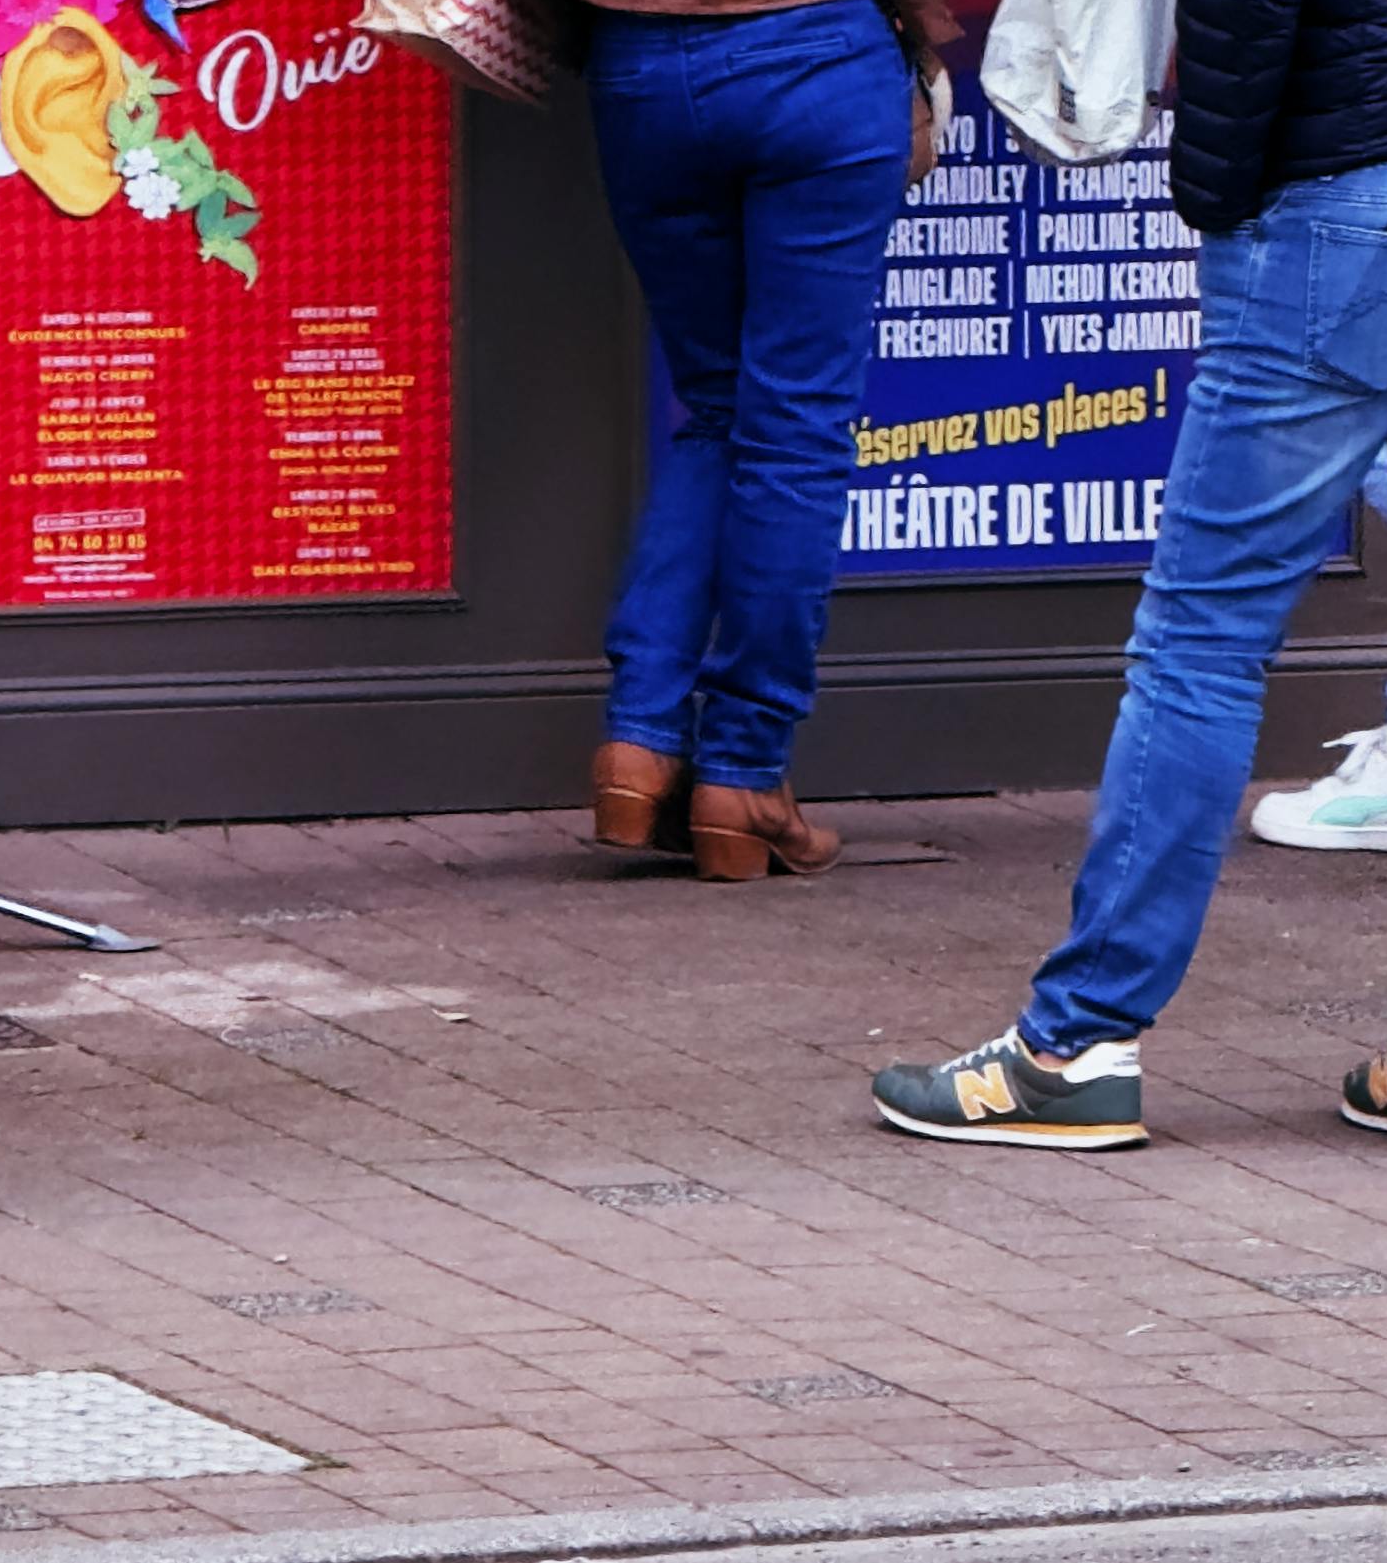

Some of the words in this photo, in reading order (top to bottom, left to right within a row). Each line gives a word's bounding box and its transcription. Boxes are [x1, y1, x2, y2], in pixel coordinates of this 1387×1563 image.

[197, 26, 379, 133] Ouïe
[1038, 212, 1140, 253] PAULINE
[885, 267, 997, 308] ANGLADE
[1026, 262, 1104, 304] MEHDI
[879, 311, 1012, 359] FRÉCHURET
[1041, 314, 1103, 354] YVES
[1107, 310, 1203, 351] JAMAIT
[850, 413, 979, 467] éservez
[984, 403, 1040, 446] vos
[1046, 382, 1147, 448] places
[1156, 367, 1167, 418] !
[841, 473, 999, 552] THÉÂTRE
[1008, 483, 1054, 546] DE
[1063, 479, 1164, 544] VILLE
